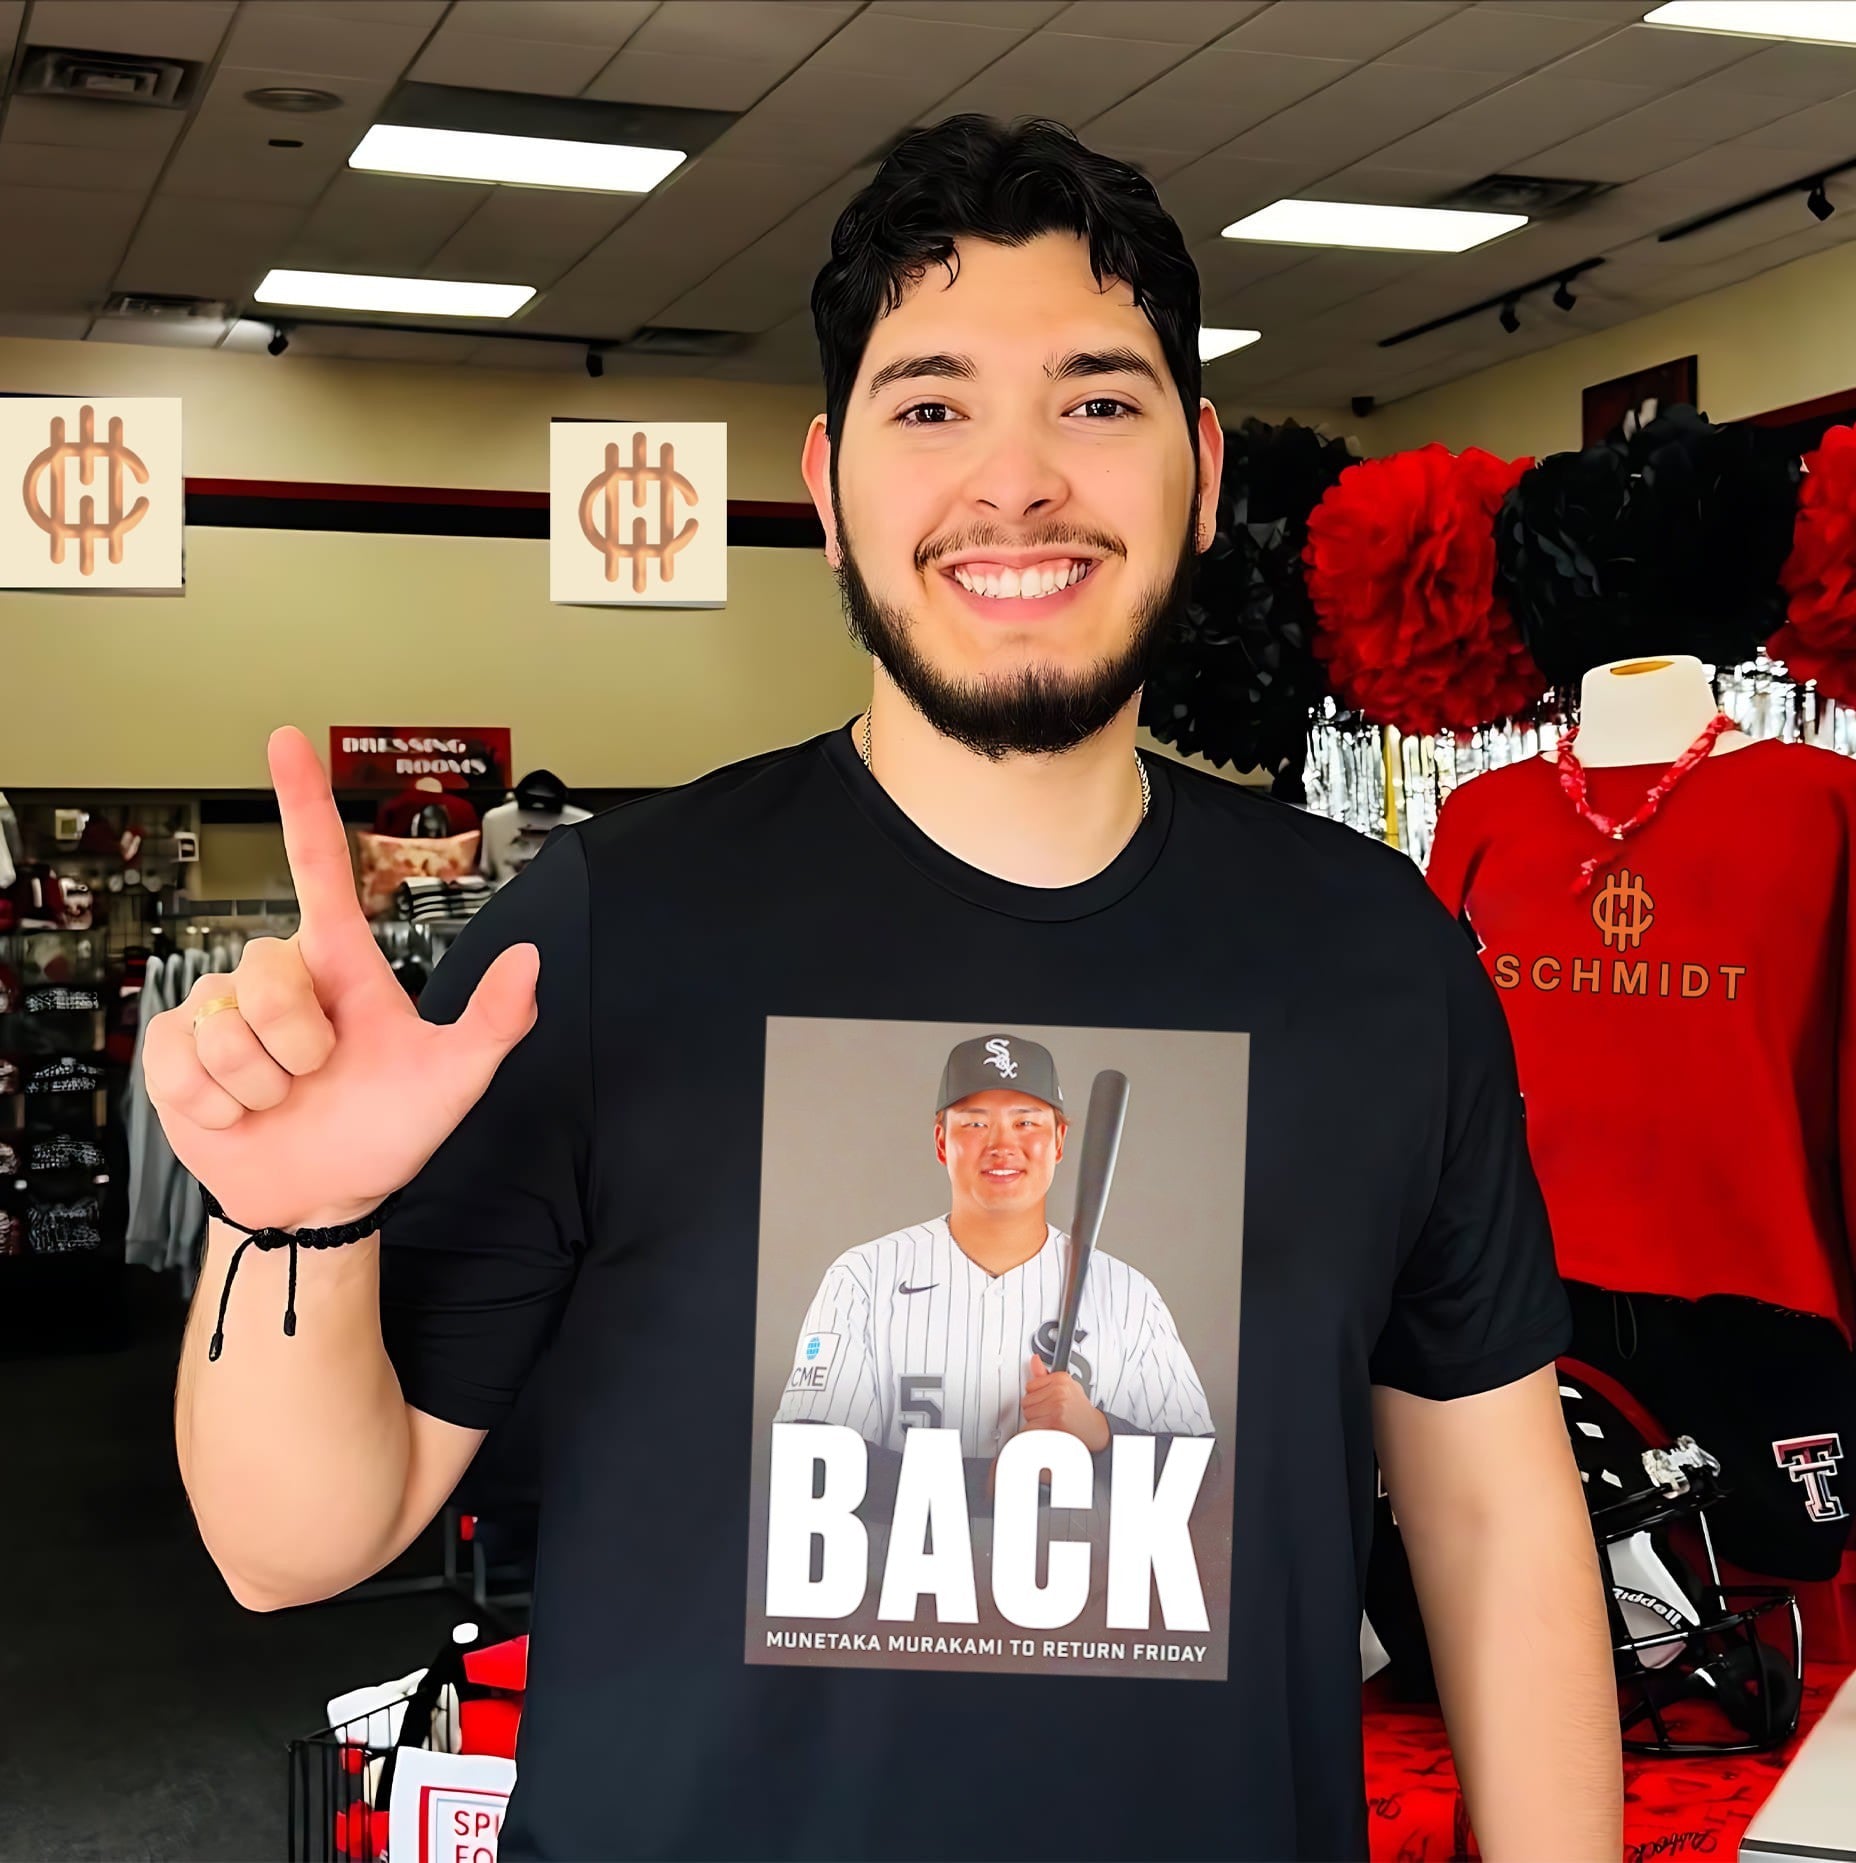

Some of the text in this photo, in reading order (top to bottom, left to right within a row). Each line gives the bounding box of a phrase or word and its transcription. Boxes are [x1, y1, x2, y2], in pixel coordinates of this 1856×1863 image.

[342, 737, 467, 753] DRESSING
[396, 758, 487, 775] ROOMS
[1494, 954, 1747, 1000] SCHMIDT
[791, 1366, 828, 1387] CME
[765, 1422, 1216, 1632] BACK
[766, 1631, 1207, 1662] MUNETAKA MURAKAMI TO RETURN FRIDAY
